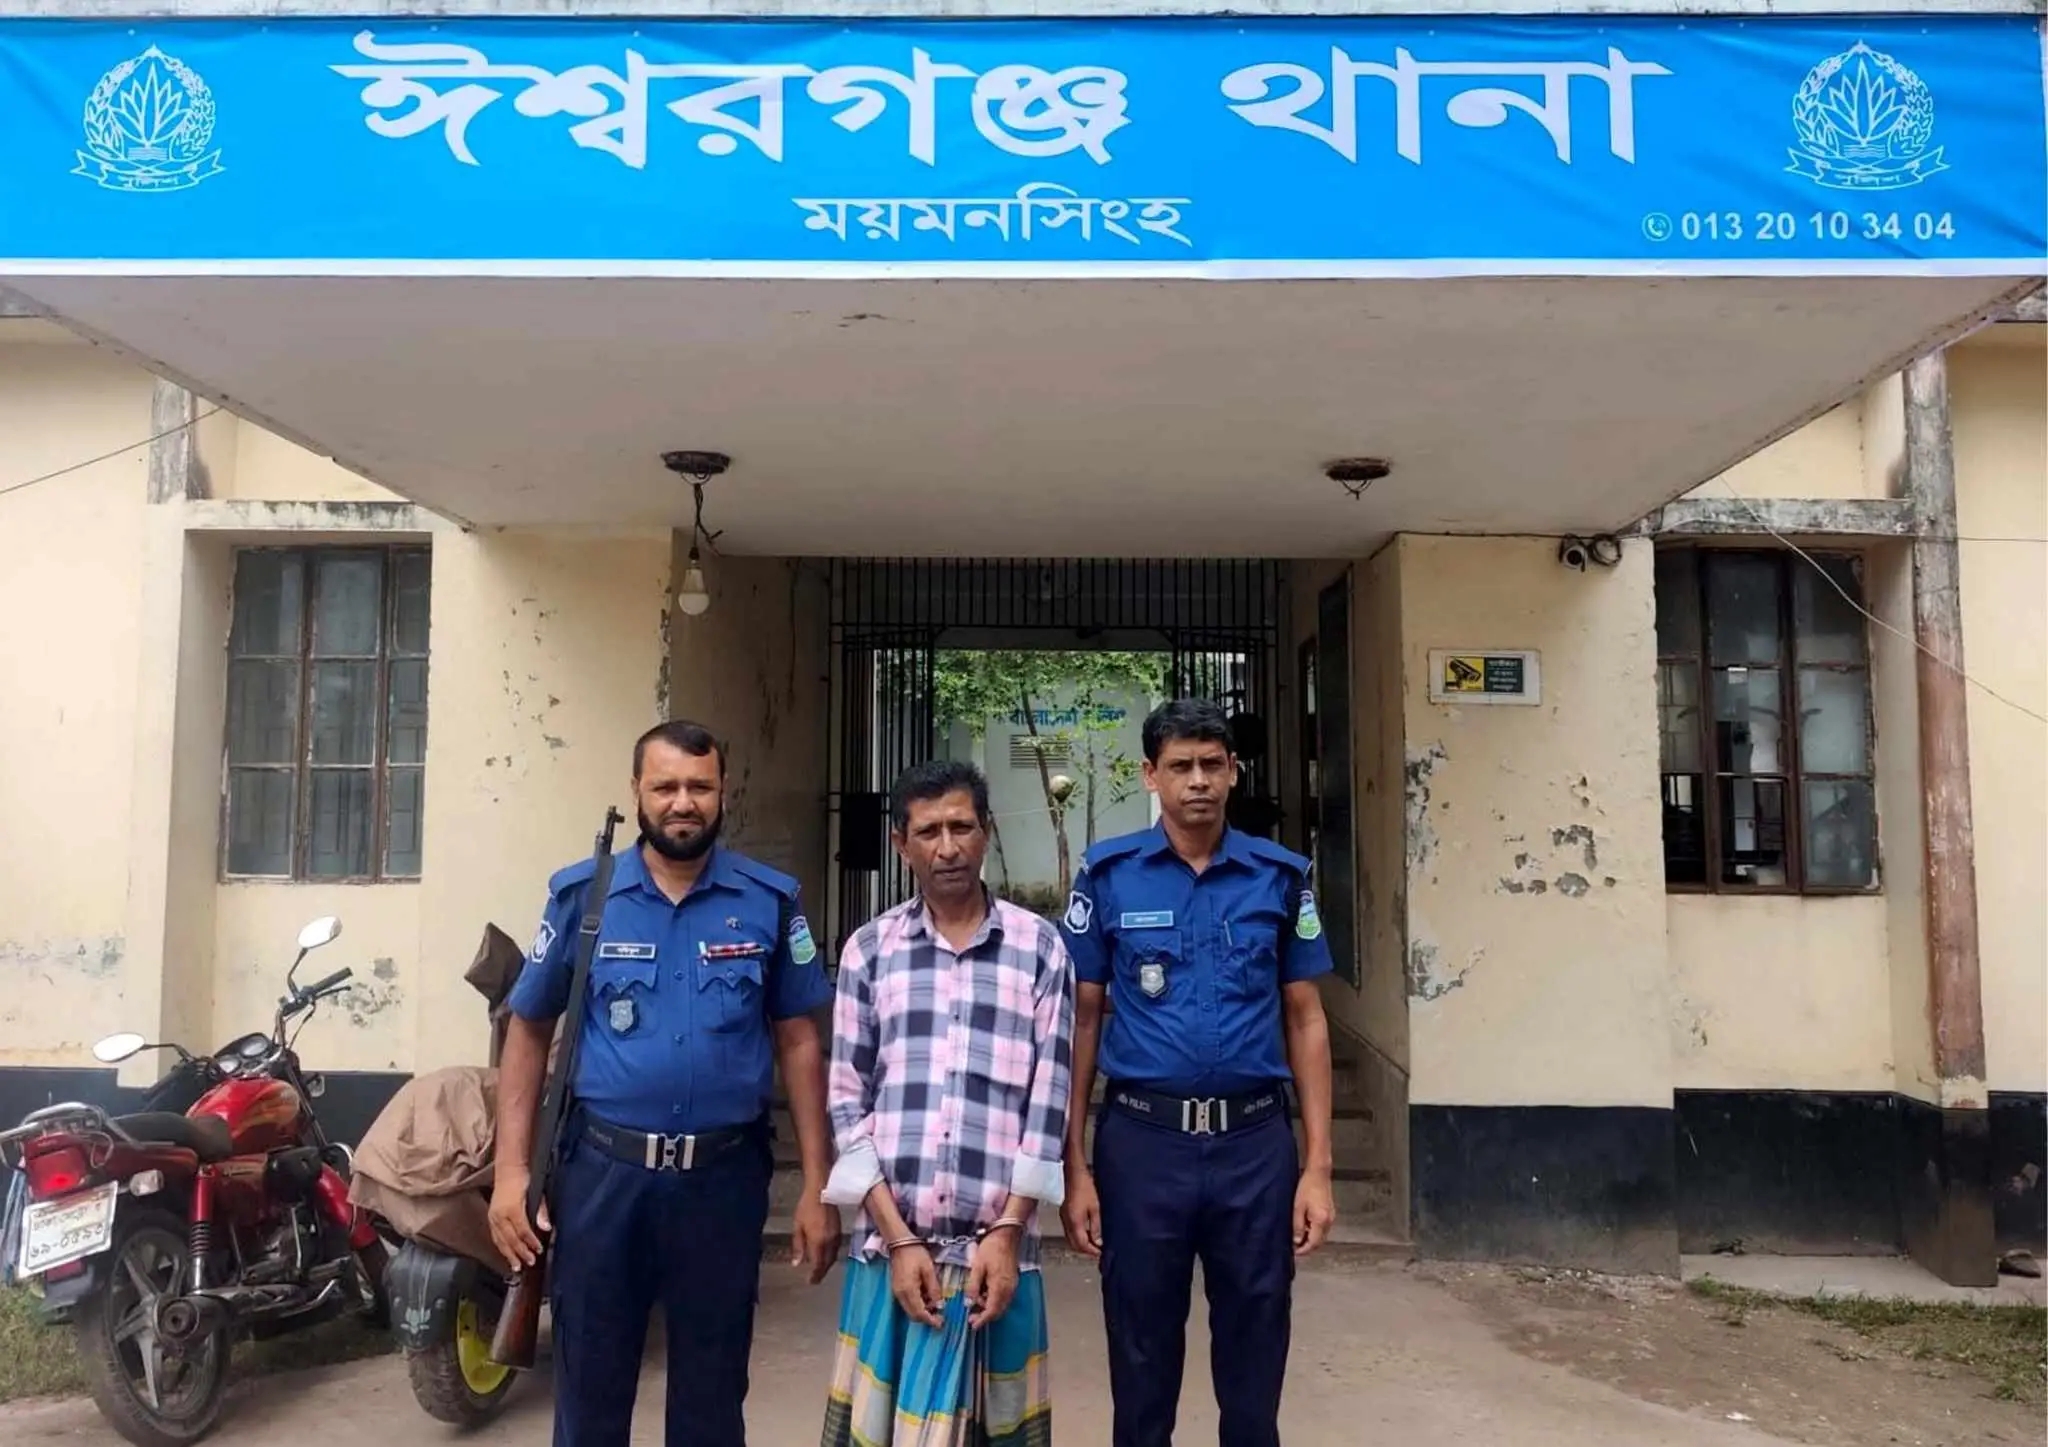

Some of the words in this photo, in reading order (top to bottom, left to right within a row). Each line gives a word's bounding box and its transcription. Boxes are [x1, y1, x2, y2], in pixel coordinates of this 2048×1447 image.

[327, 31, 1132, 169] ঈশ্বরগঞ্জ
[1219, 46, 1674, 165] থানা
[793, 182, 1194, 248] ময়মনসিংহ
[1681, 213, 1743, 240] 013
[1756, 213, 1796, 240] 20
[1809, 213, 1849, 240] 10
[1863, 213, 1901, 240] 34
[1913, 213, 1956, 240] 04
